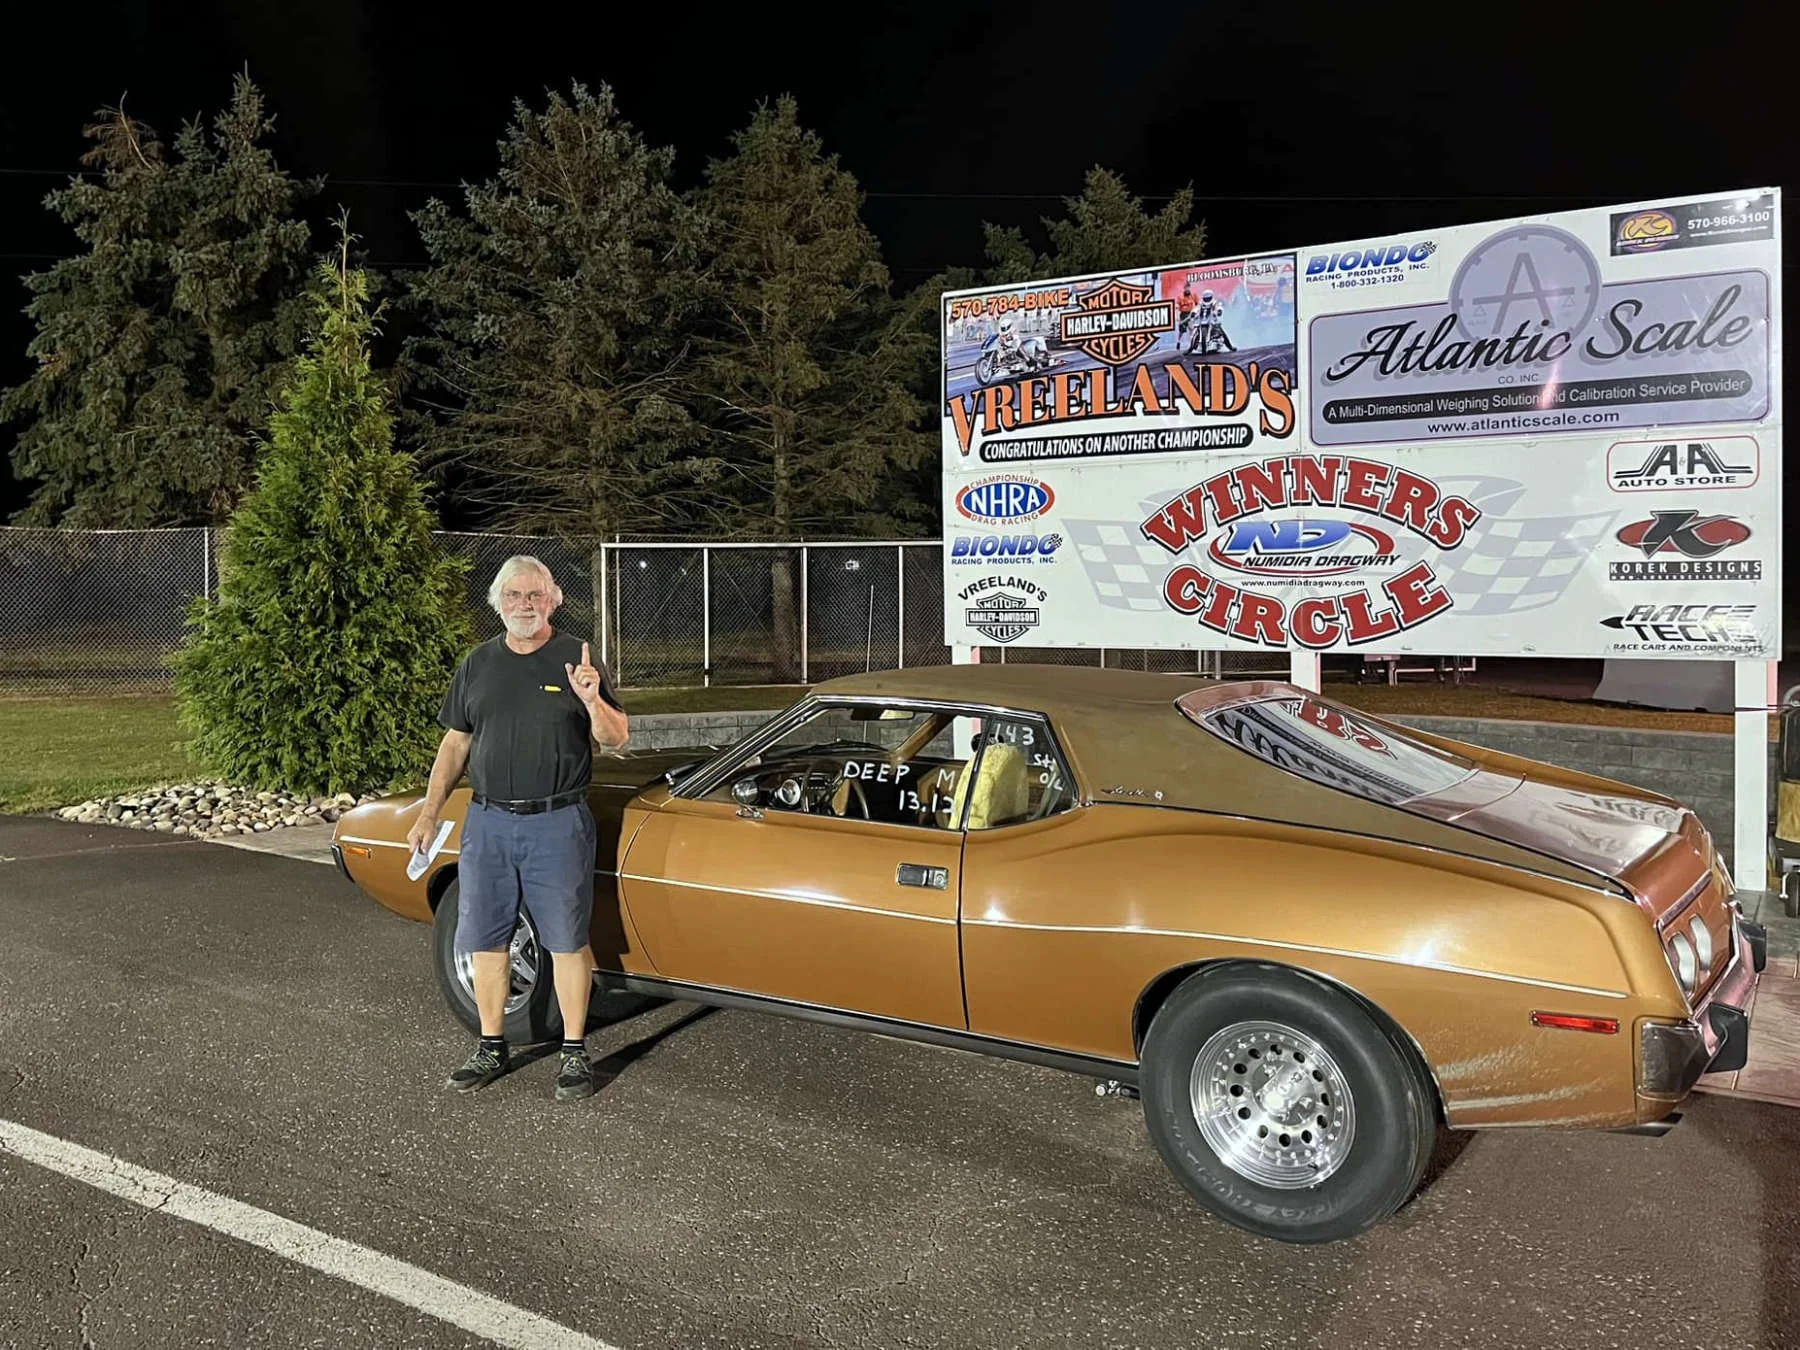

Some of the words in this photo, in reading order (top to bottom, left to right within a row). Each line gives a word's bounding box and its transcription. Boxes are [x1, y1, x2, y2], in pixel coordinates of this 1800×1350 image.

[1687, 211, 1770, 230] 570-966-3100
[1305, 241, 1432, 275] BIONDO
[1306, 273, 1342, 283] RACING
[1331, 275, 1404, 289] 1-800-332-1320
[951, 288, 1071, 319] 570-784-BIKE
[1088, 285, 1142, 309] MOTOR
[1066, 308, 1169, 334] HARLEY-DAVIDSON
[1326, 313, 1571, 381] Atlantic
[1586, 284, 1752, 359] Scale
[1091, 334, 1147, 359] CYCLES
[949, 362, 1296, 457] VREELAND'S
[1328, 408, 1337, 419] A
[1339, 399, 1434, 418] Multi-Dimensional
[1436, 396, 1489, 412] Weighing
[1492, 393, 1546, 407] Solution
[1570, 386, 1635, 401] Calibration
[1640, 383, 1687, 396] Service
[1691, 378, 1745, 393] Provider
[1428, 411, 1620, 433] www.atlanticscale.com
[985, 437, 1084, 460] CONGRATULATIONS
[1085, 436, 1101, 452] ON
[1103, 433, 1155, 451] ANOTHER
[1158, 427, 1248, 448] CHAMPIONSHIP
[970, 474, 1040, 488] CHAMPIONSHIP
[1617, 478, 1667, 487] AUTO
[1674, 476, 1736, 485] STORE
[970, 482, 1041, 517] NHRA
[1141, 454, 1482, 553] WINNERS
[971, 513, 997, 526] DRAG
[1001, 512, 1039, 526] RACING
[951, 534, 1058, 557] BIONDO
[952, 557, 982, 565] RACING
[1040, 556, 1057, 564] INC.
[1242, 555, 1310, 567] NUMIDIA
[1315, 554, 1401, 567] DRAGWAY
[1610, 563, 1667, 574] KOREK
[1680, 561, 1761, 573] DESIGNS
[958, 575, 1048, 602] VREELAND'S
[1241, 579, 1365, 588] www.numidiadragway.com
[983, 599, 1019, 609] MOTOR
[1164, 561, 1454, 648] CIRCLE
[969, 611, 1036, 623] HARLEY-DAVIDSON
[1625, 623, 1732, 641] TECH
[1613, 643, 1638, 651] RACE
[1641, 643, 1666, 651] CARS
[993, 723, 1034, 745] 143
[843, 761, 911, 784] DEEP
